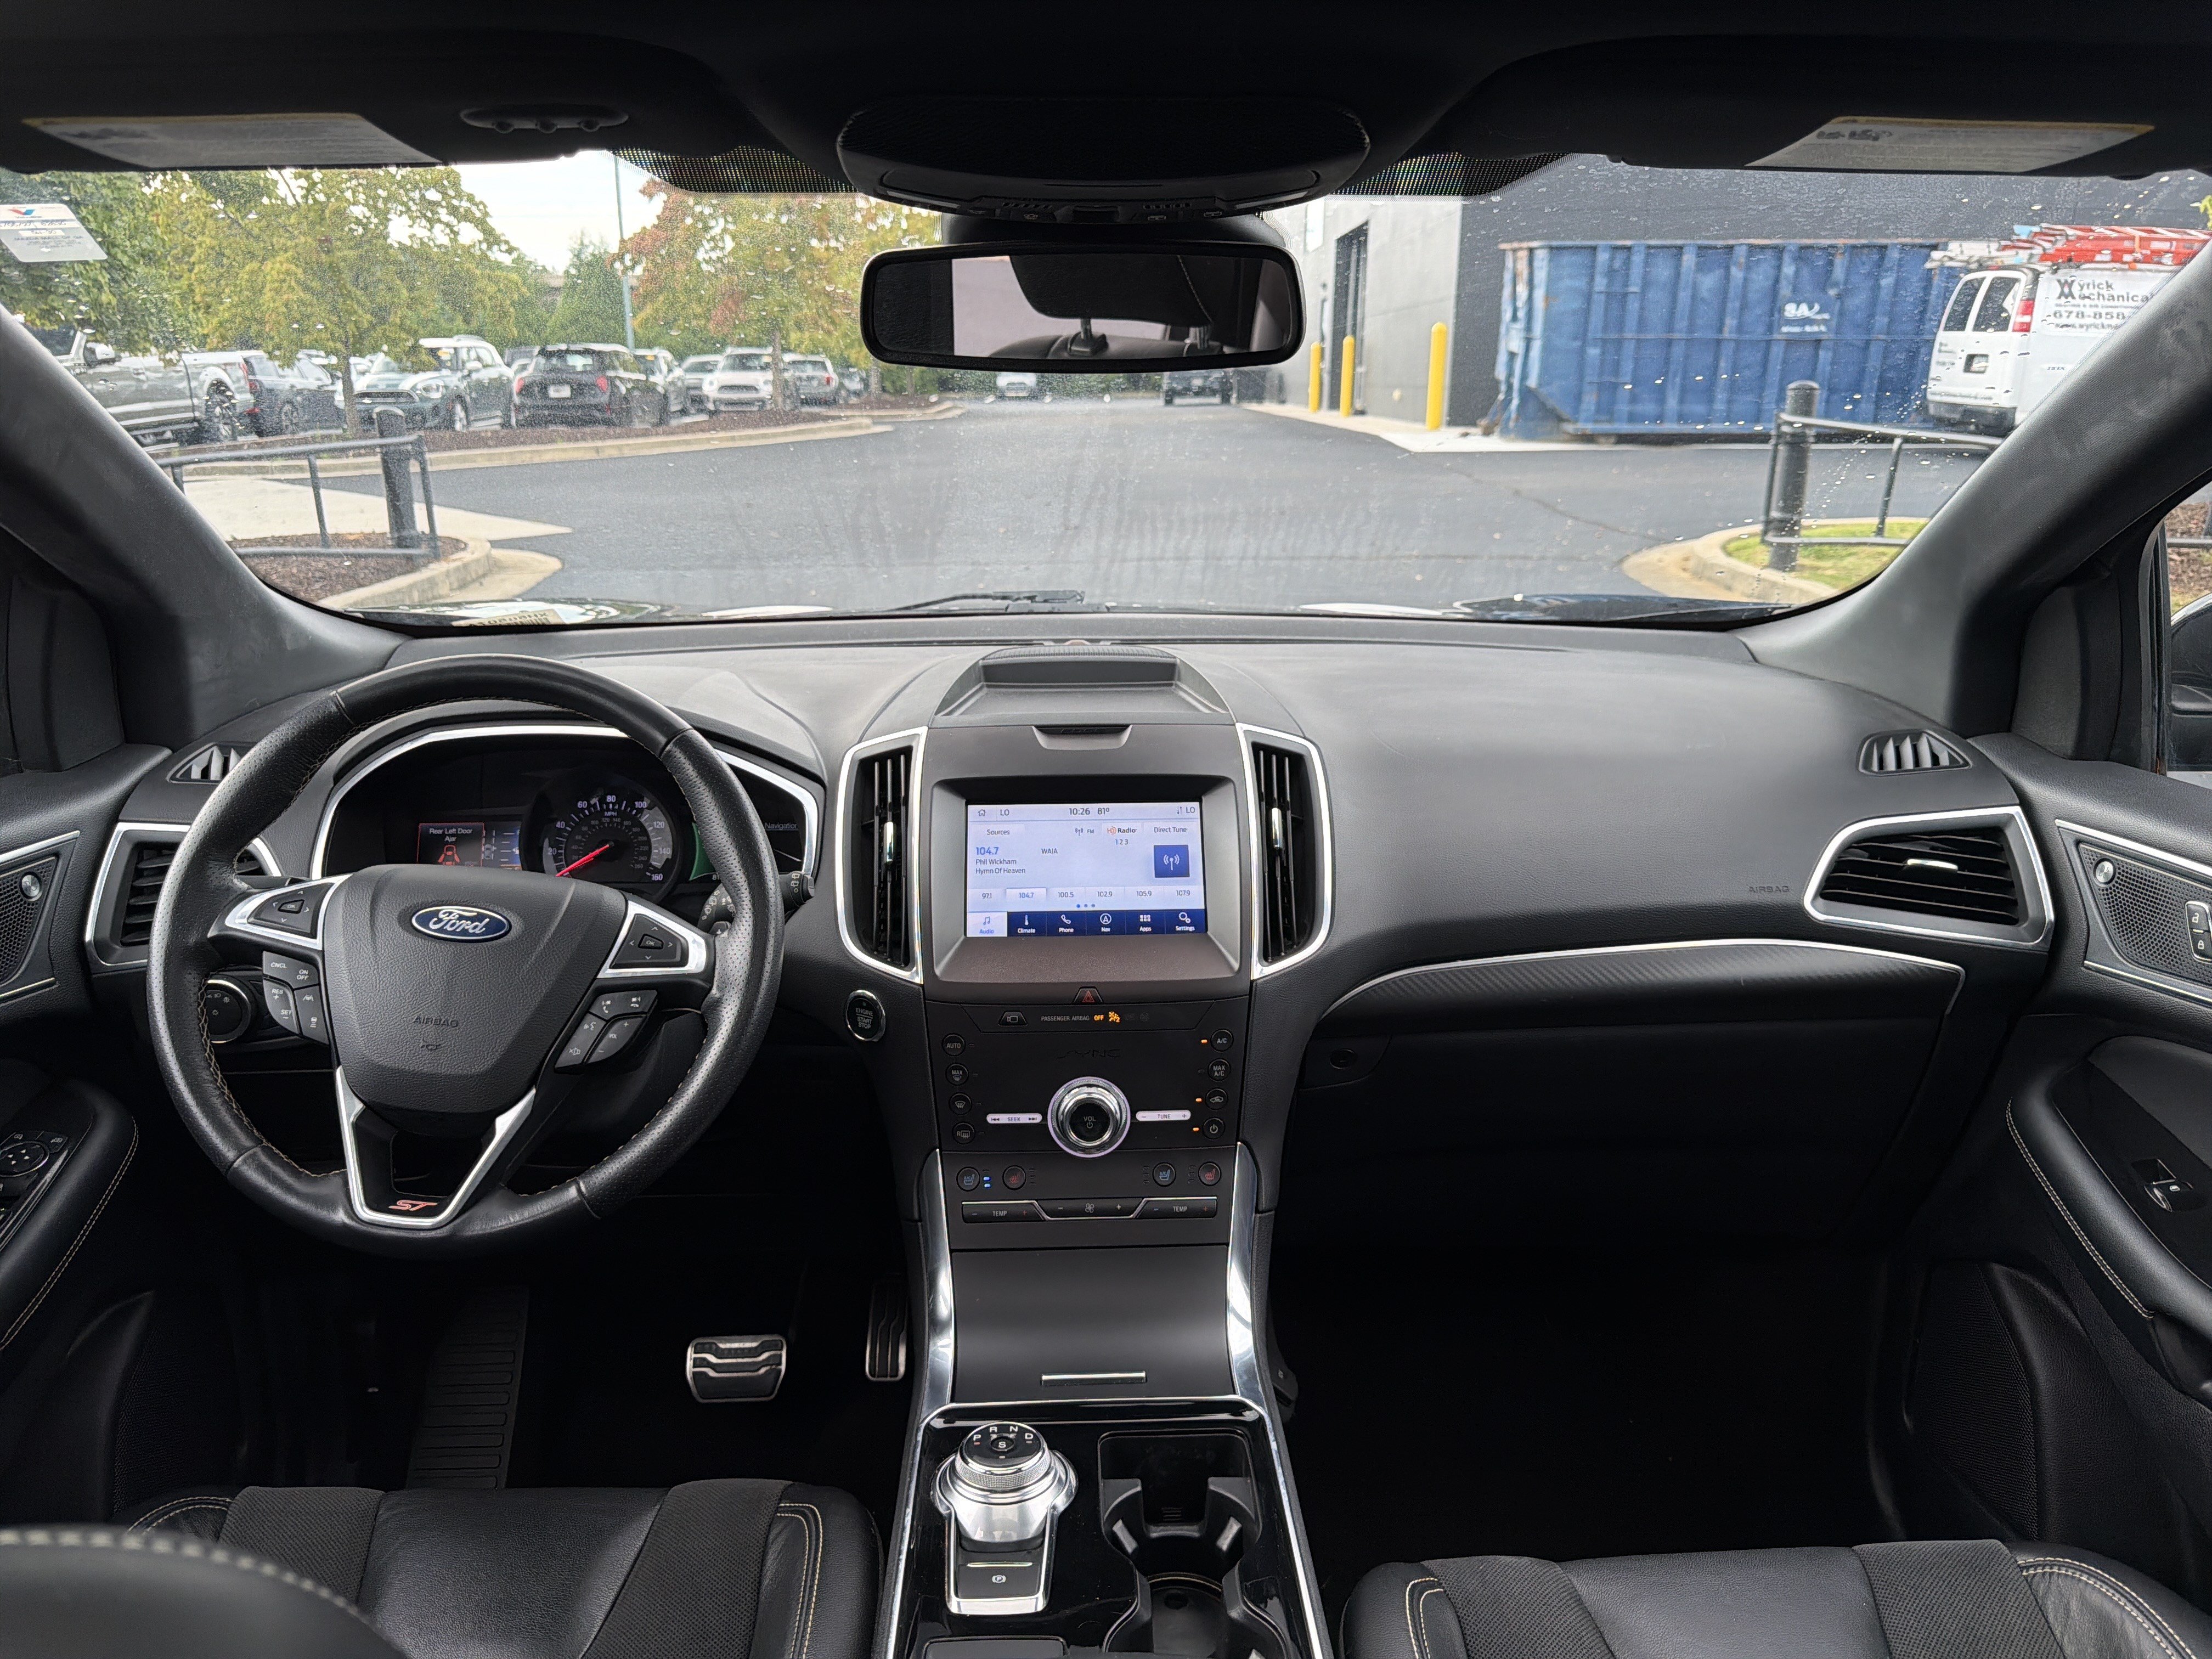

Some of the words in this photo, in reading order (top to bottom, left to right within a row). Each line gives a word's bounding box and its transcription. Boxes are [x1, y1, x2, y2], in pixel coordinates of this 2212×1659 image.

[578, 800, 588, 809] 60
[1069, 808, 1091, 816] 10:26
[975, 847, 999, 856] 104.7
[975, 867, 994, 876] Hymn
[1748, 885, 1790, 893] AIRBAG
[429, 909, 489, 934] Ford
[855, 1007, 873, 1017] ENGINE
[413, 1015, 459, 1028] AIRBAG
[388, 1199, 438, 1211] ST
